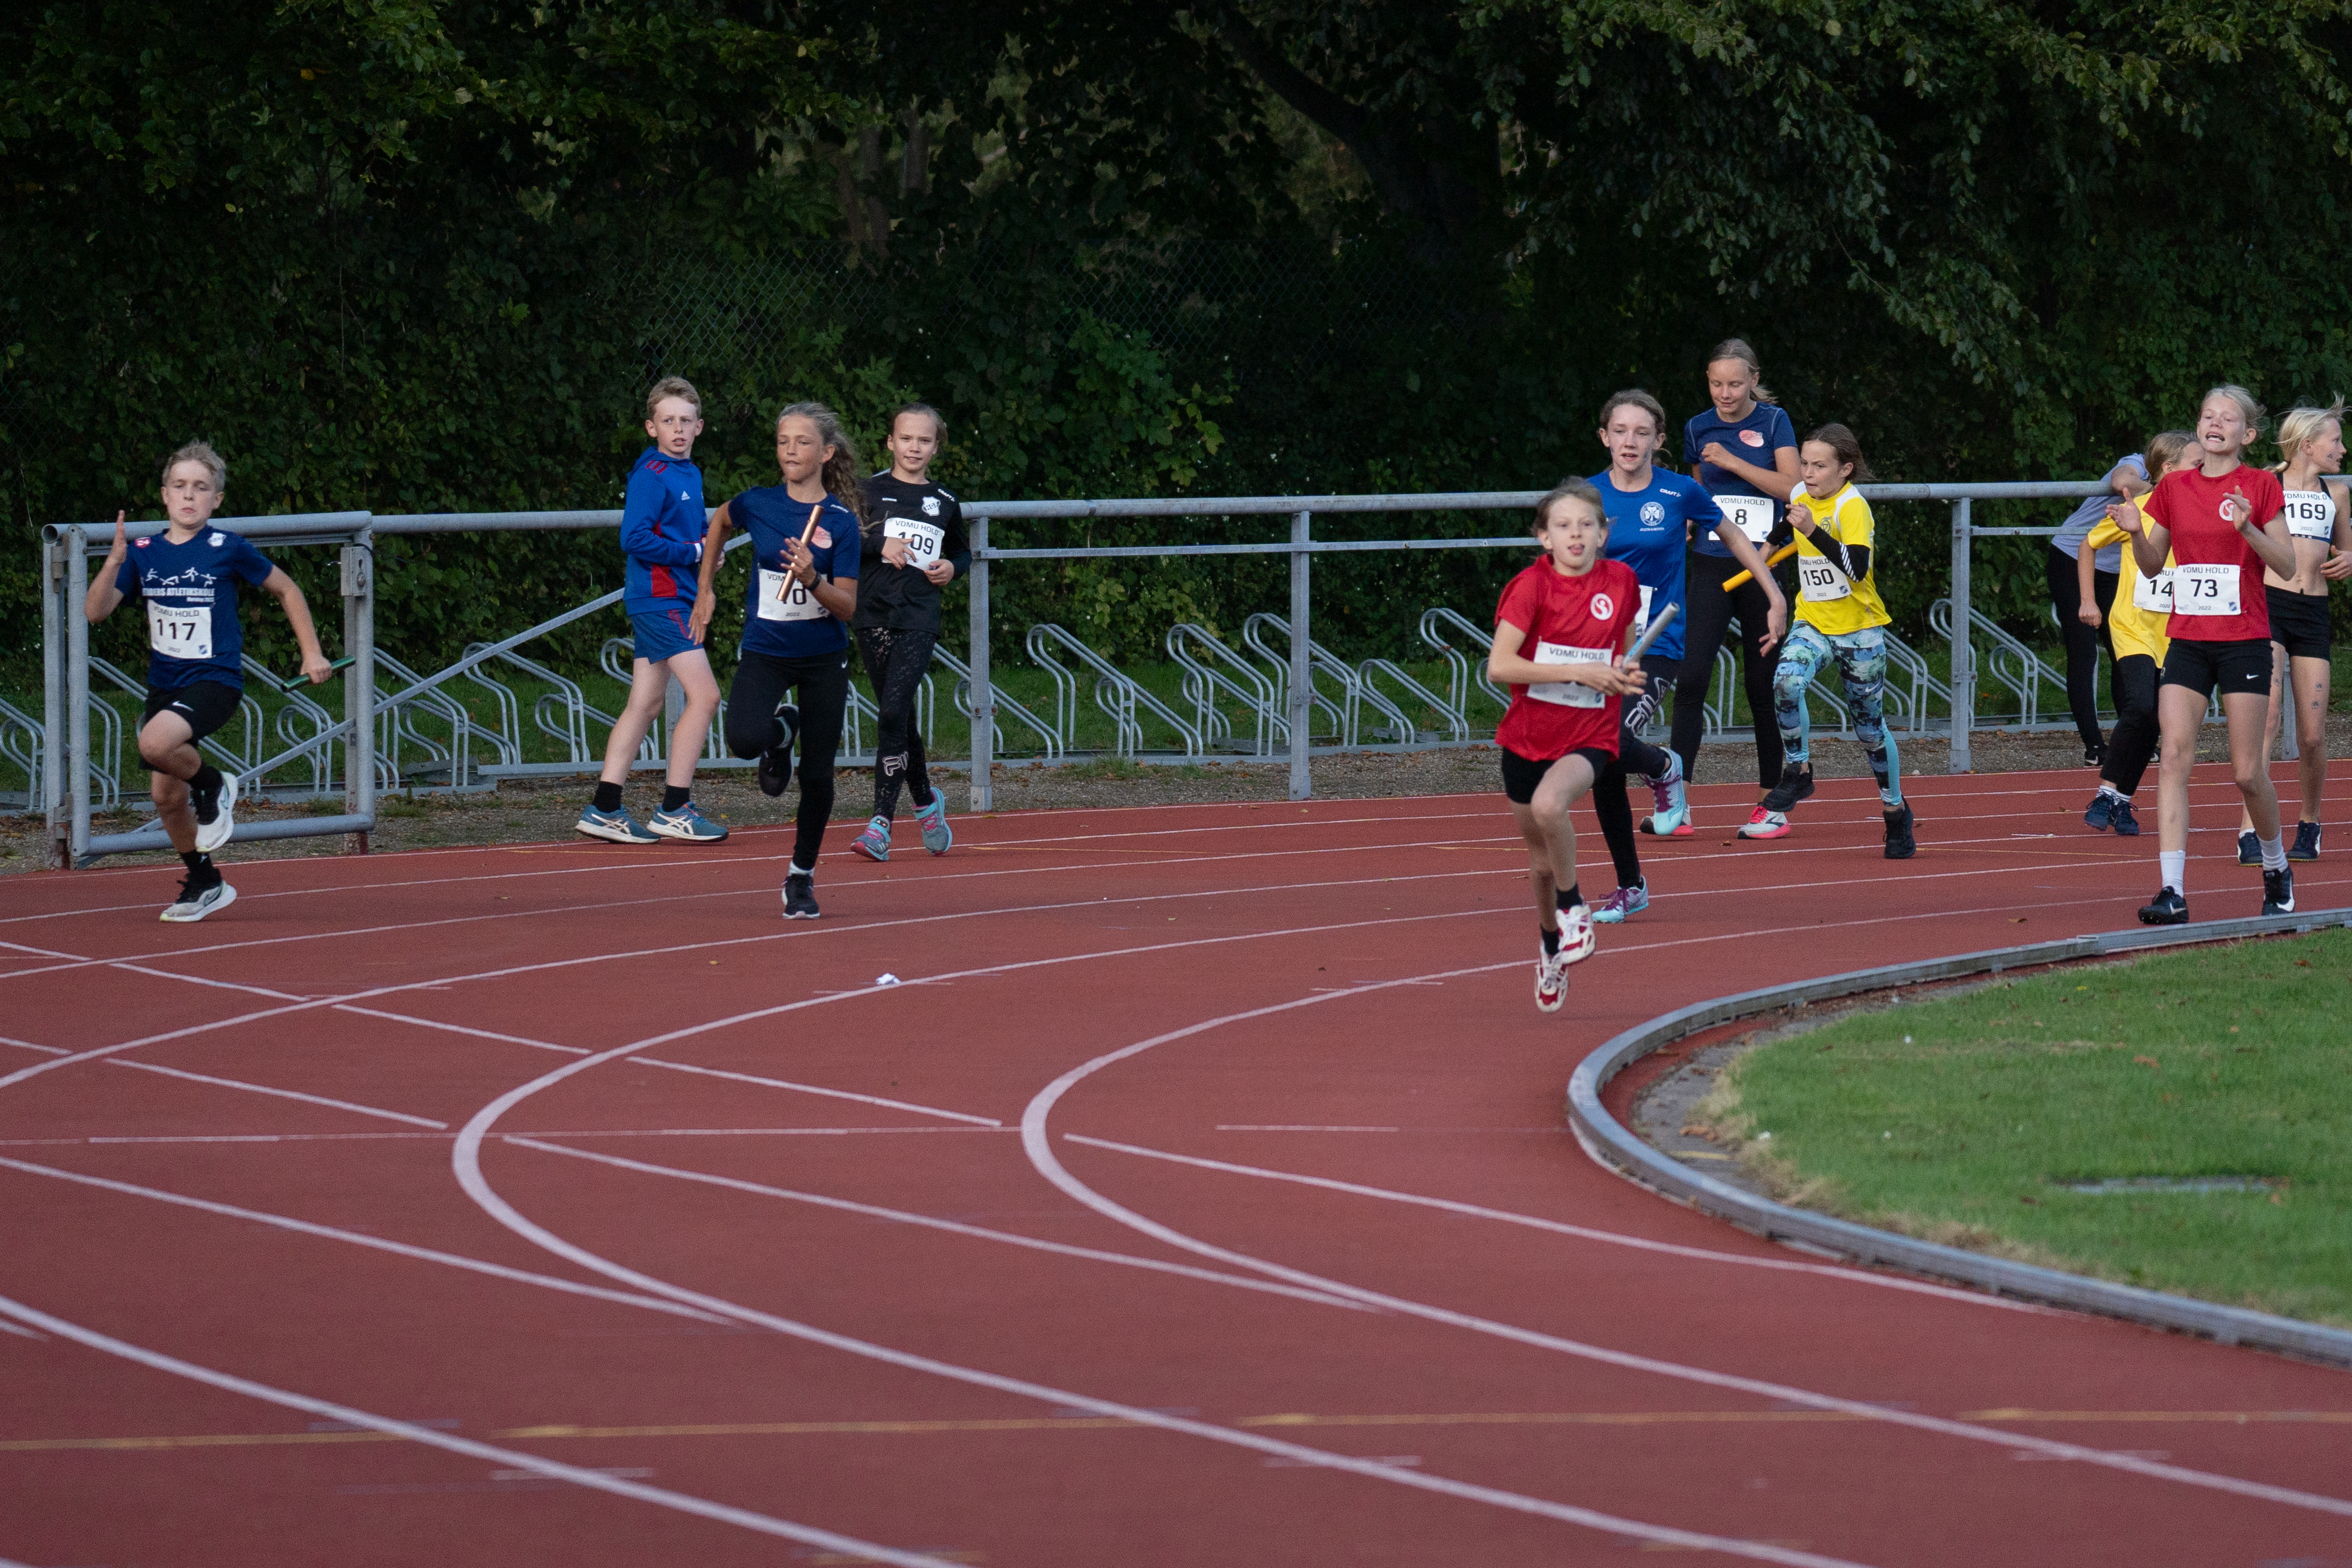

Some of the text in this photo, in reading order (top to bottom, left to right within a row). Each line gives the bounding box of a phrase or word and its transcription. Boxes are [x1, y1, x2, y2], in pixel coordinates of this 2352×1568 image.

[1735, 509, 1747, 525] 8
[2287, 503, 2326, 521] 169
[895, 520, 939, 536] VDMU HOLD
[768, 573, 786, 582] VDM
[1803, 569, 1834, 586] 150
[2191, 579, 2218, 597] 73
[782, 589, 807, 605] 0
[157, 619, 196, 641] 117
[1549, 647, 1605, 661] VDMU HOLD
